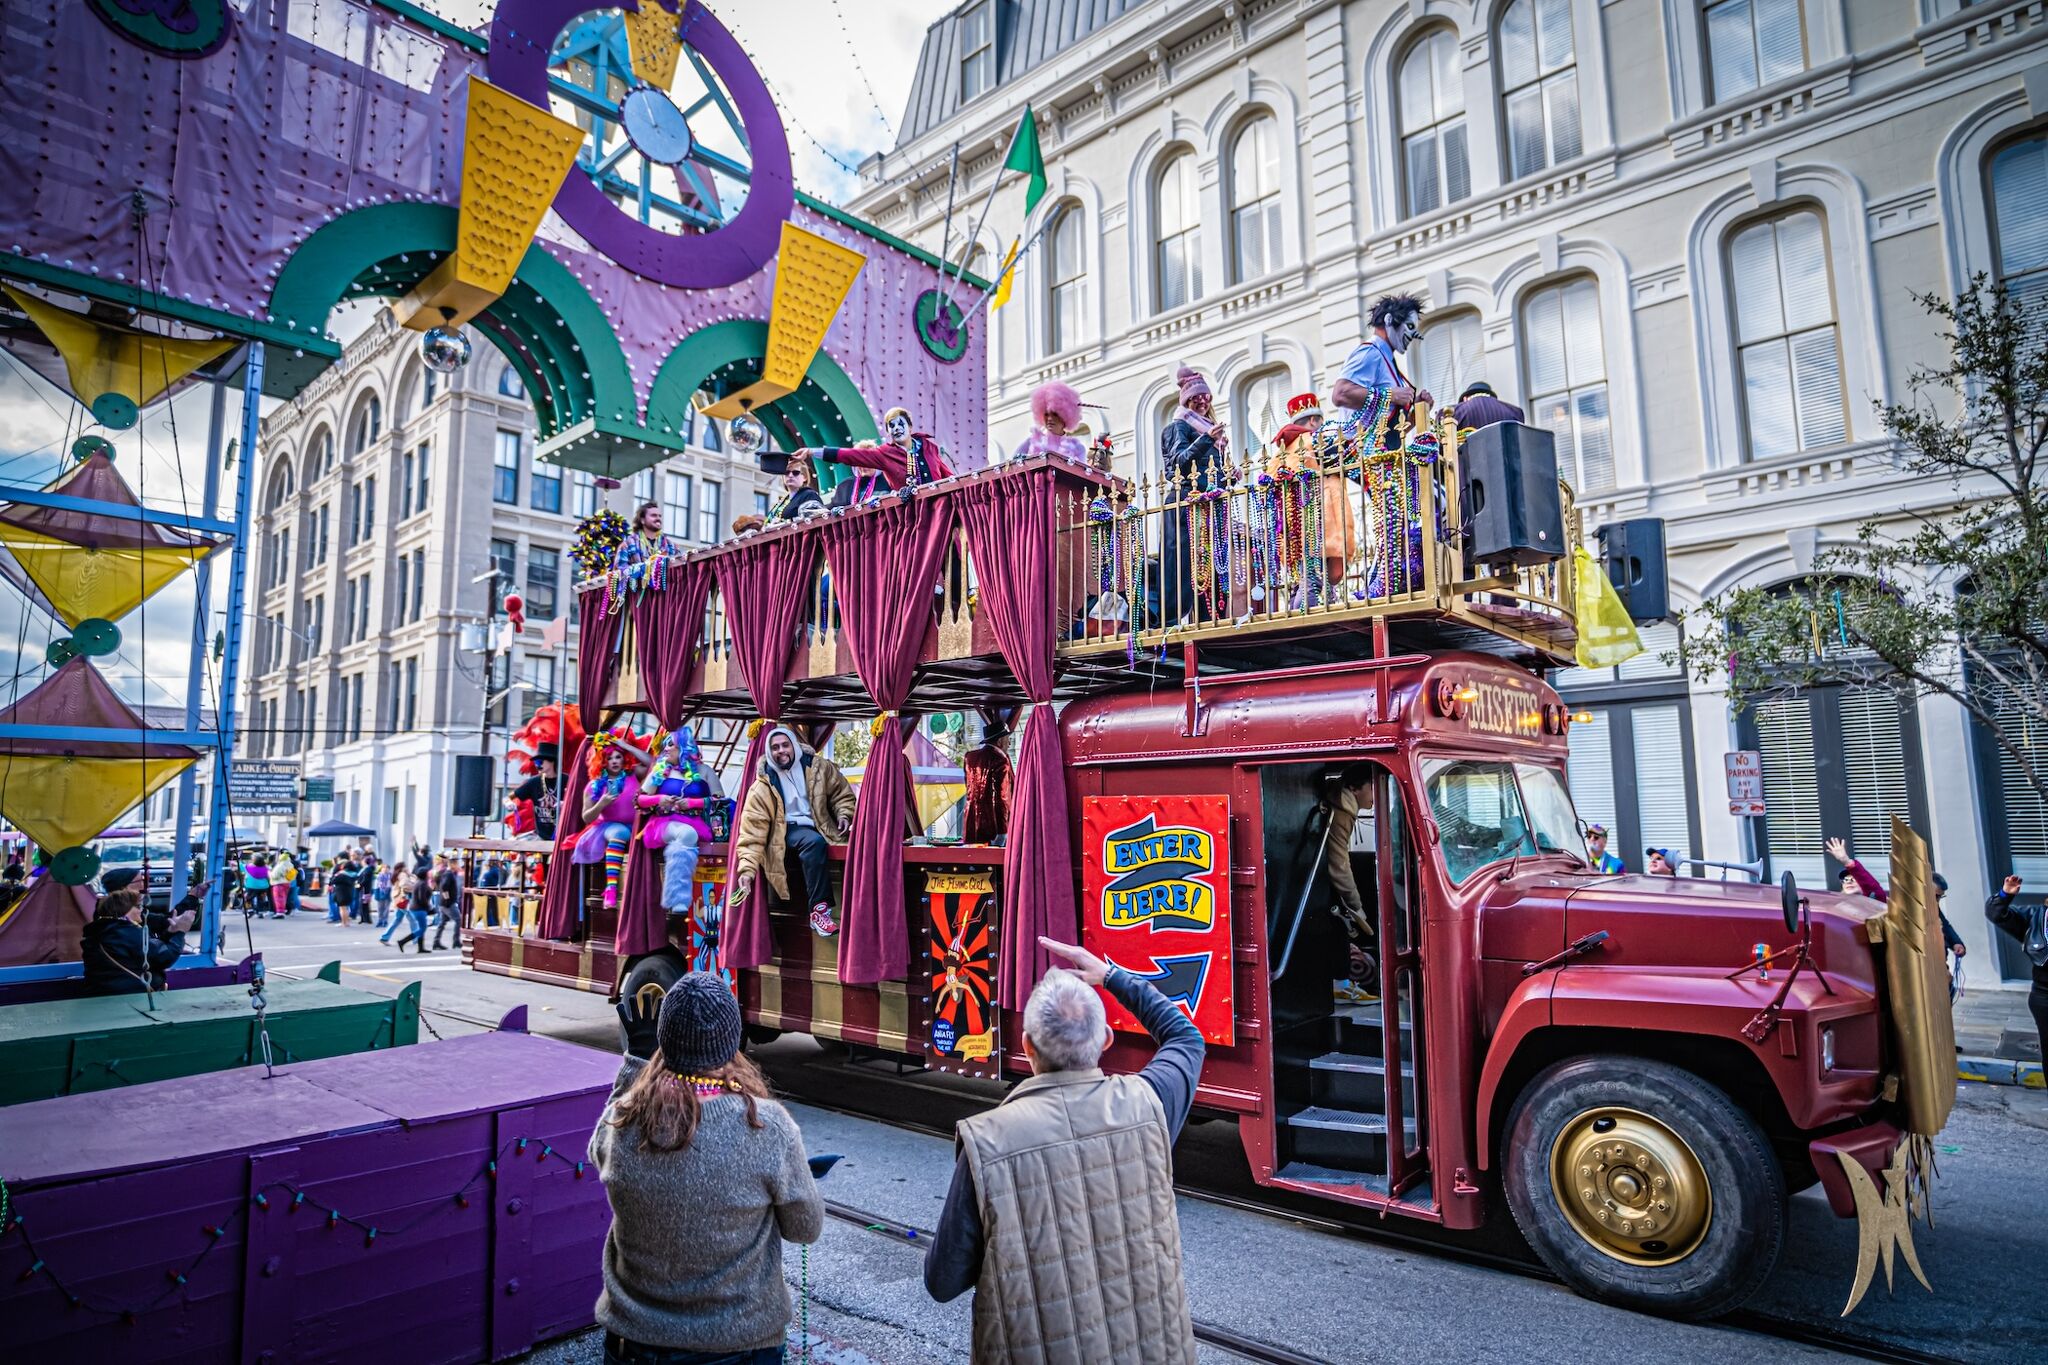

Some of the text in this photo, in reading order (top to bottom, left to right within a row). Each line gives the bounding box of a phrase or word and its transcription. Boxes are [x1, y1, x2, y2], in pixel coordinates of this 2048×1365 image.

[1468, 680, 1540, 738] MISFITS
[231, 763, 260, 774] LARKE
[268, 762, 300, 774] COURTS
[1735, 756, 1749, 766] NO
[1728, 768, 1759, 778] PARKING
[1115, 833, 1203, 867] ENTER
[931, 876, 986, 891] THE FLYING GIRL
[1111, 884, 1203, 920] HERE!
